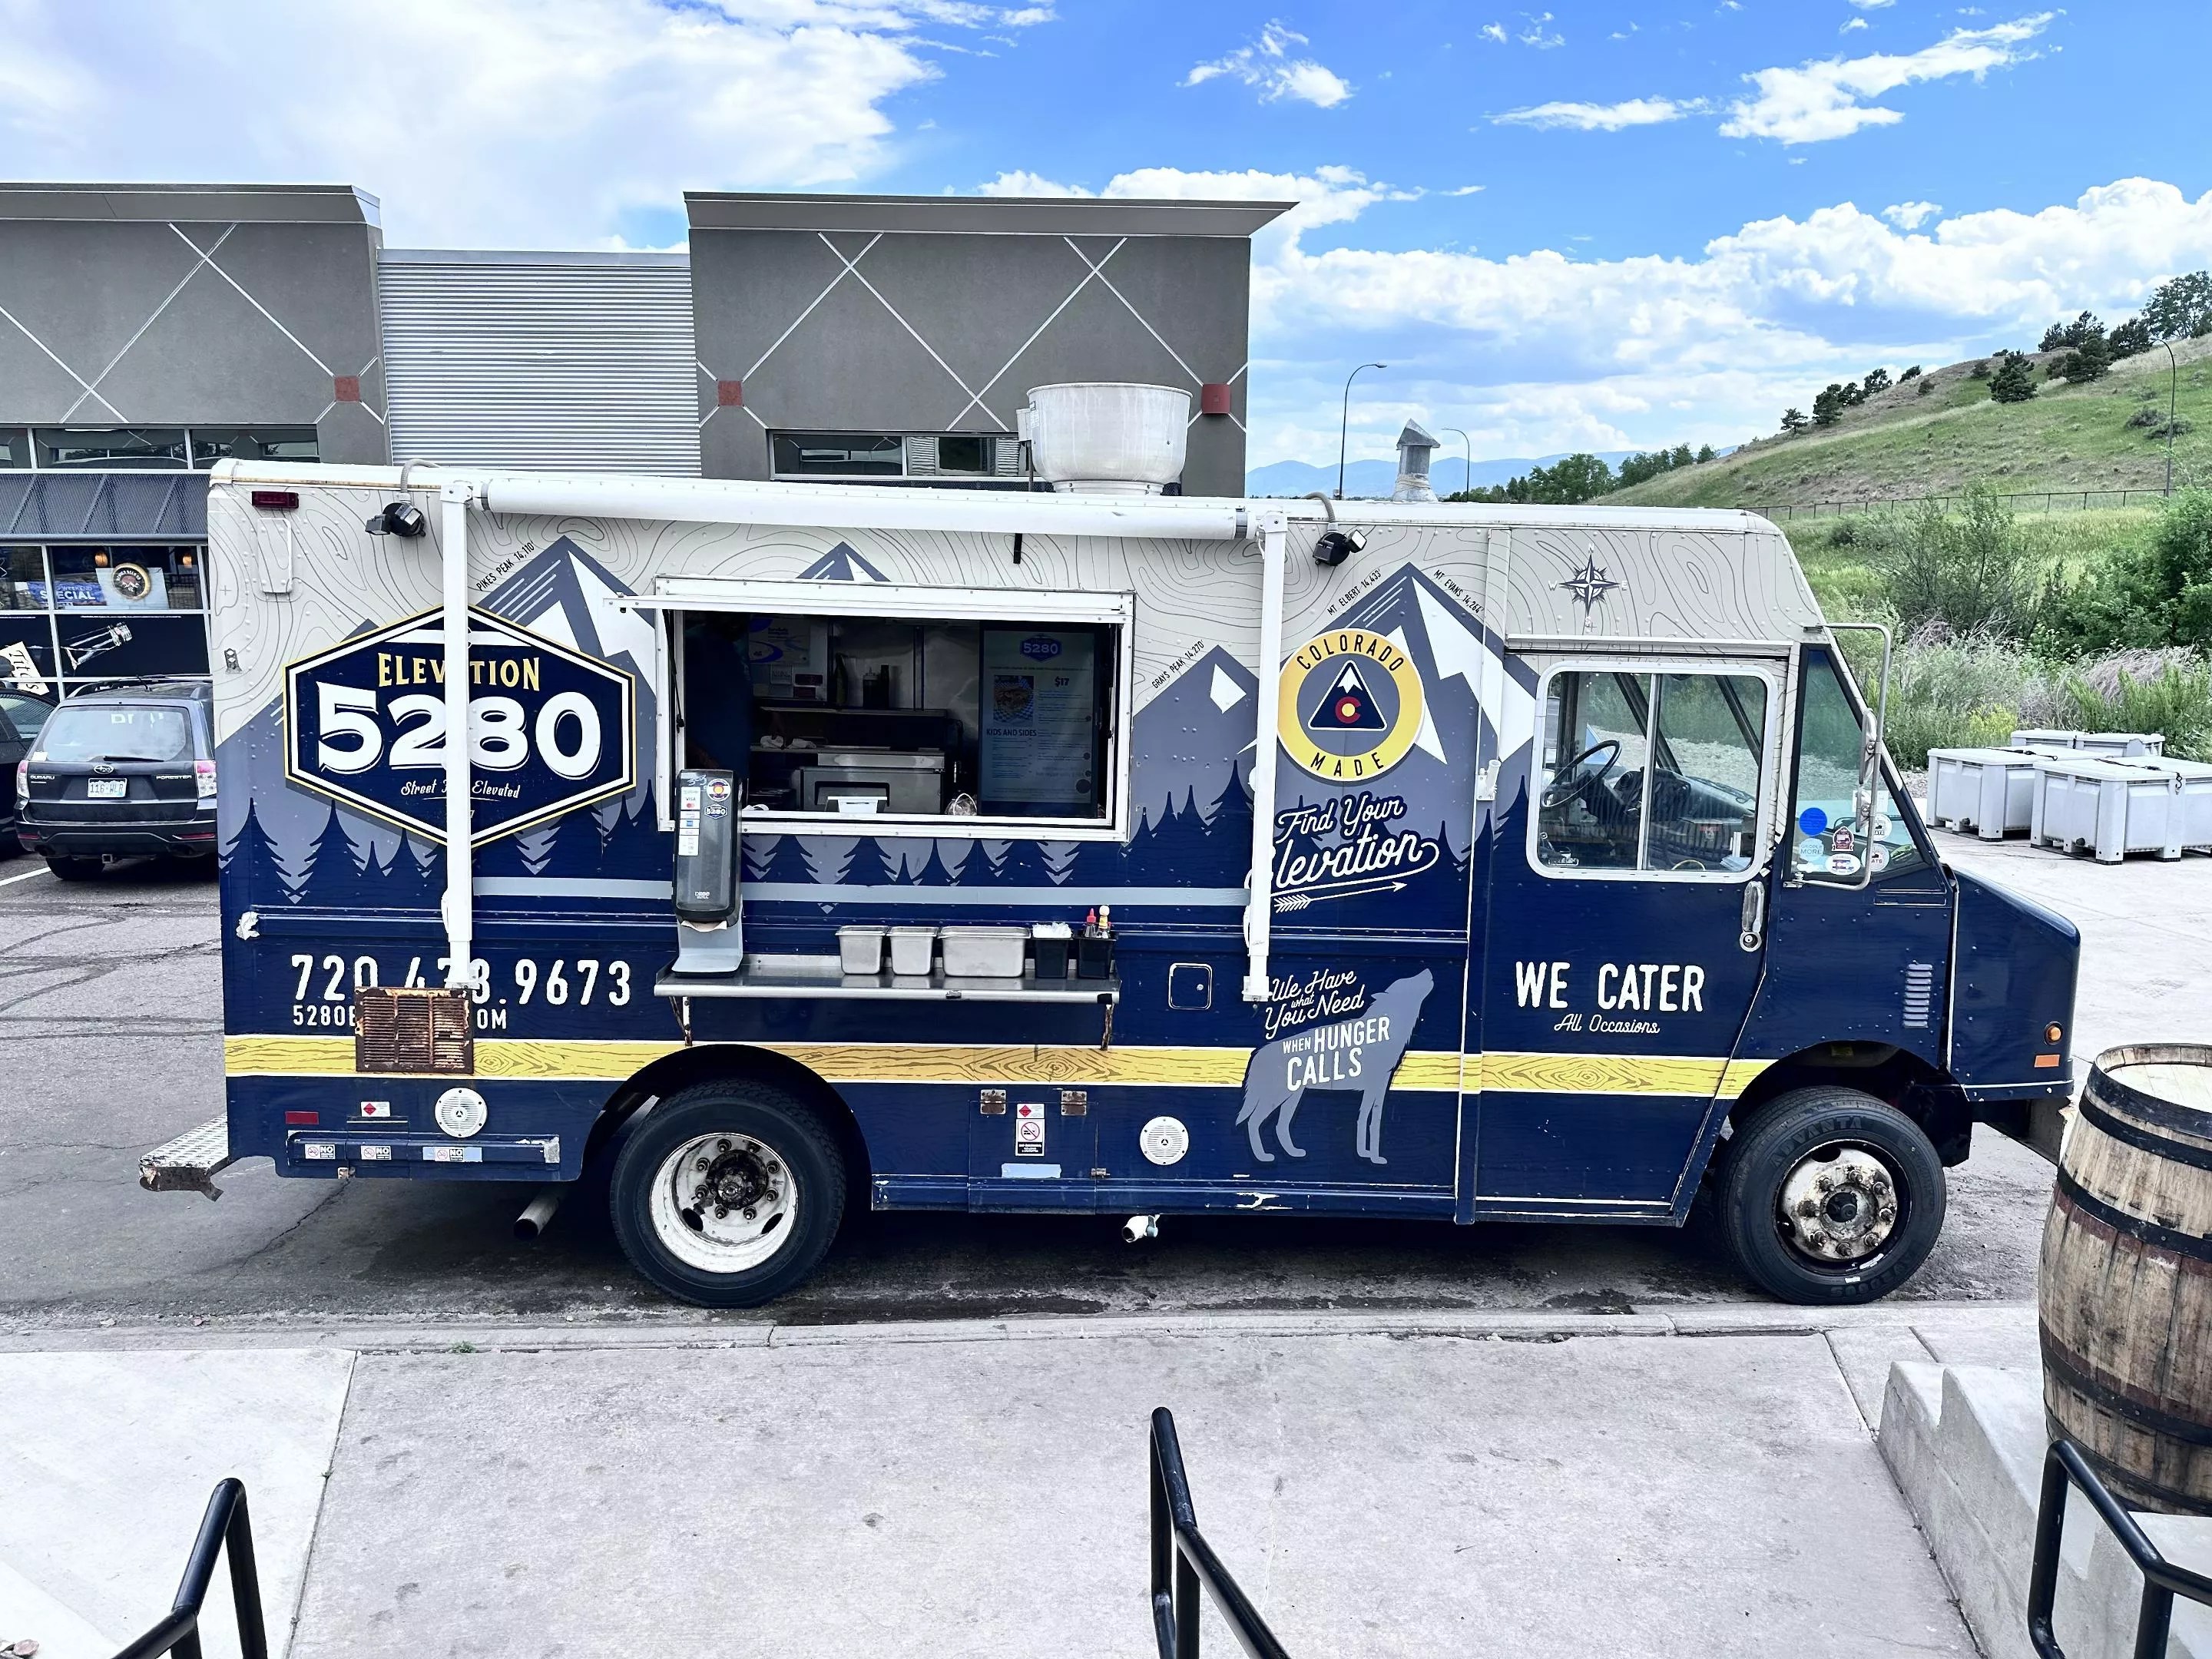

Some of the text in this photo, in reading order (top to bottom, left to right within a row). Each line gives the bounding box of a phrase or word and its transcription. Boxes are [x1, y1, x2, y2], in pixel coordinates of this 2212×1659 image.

[476, 573, 497, 591] PIKES
[496, 558, 515, 576] PEAK
[1445, 579, 1463, 596] EVANS
[39, 590, 96, 600] SECIAL
[1339, 586, 1360, 606] ELBERT
[1023, 642, 1058, 654] 5280
[1296, 634, 1404, 671] COLORADO
[378, 652, 540, 691] ELEVTION
[1055, 676, 1070, 687] $17
[1152, 671, 1171, 688] GRAYS
[1170, 657, 1186, 673] PEAK
[316, 681, 604, 780] 5280
[1310, 752, 1384, 777] MADE
[400, 779, 437, 796] Street
[472, 780, 521, 799] Elevated
[1275, 794, 1403, 844] Find Your
[1245, 823, 1439, 890] levation
[1271, 968, 1357, 1002] We Have
[1291, 992, 1315, 1008] what
[1515, 961, 1705, 1012] WE CATER
[1265, 984, 1366, 1040] You Need
[1554, 1013, 1661, 1034] All Occasions
[1283, 1016, 1390, 1055] WHEN HUNGER
[1287, 1047, 1363, 1091] CALLS
